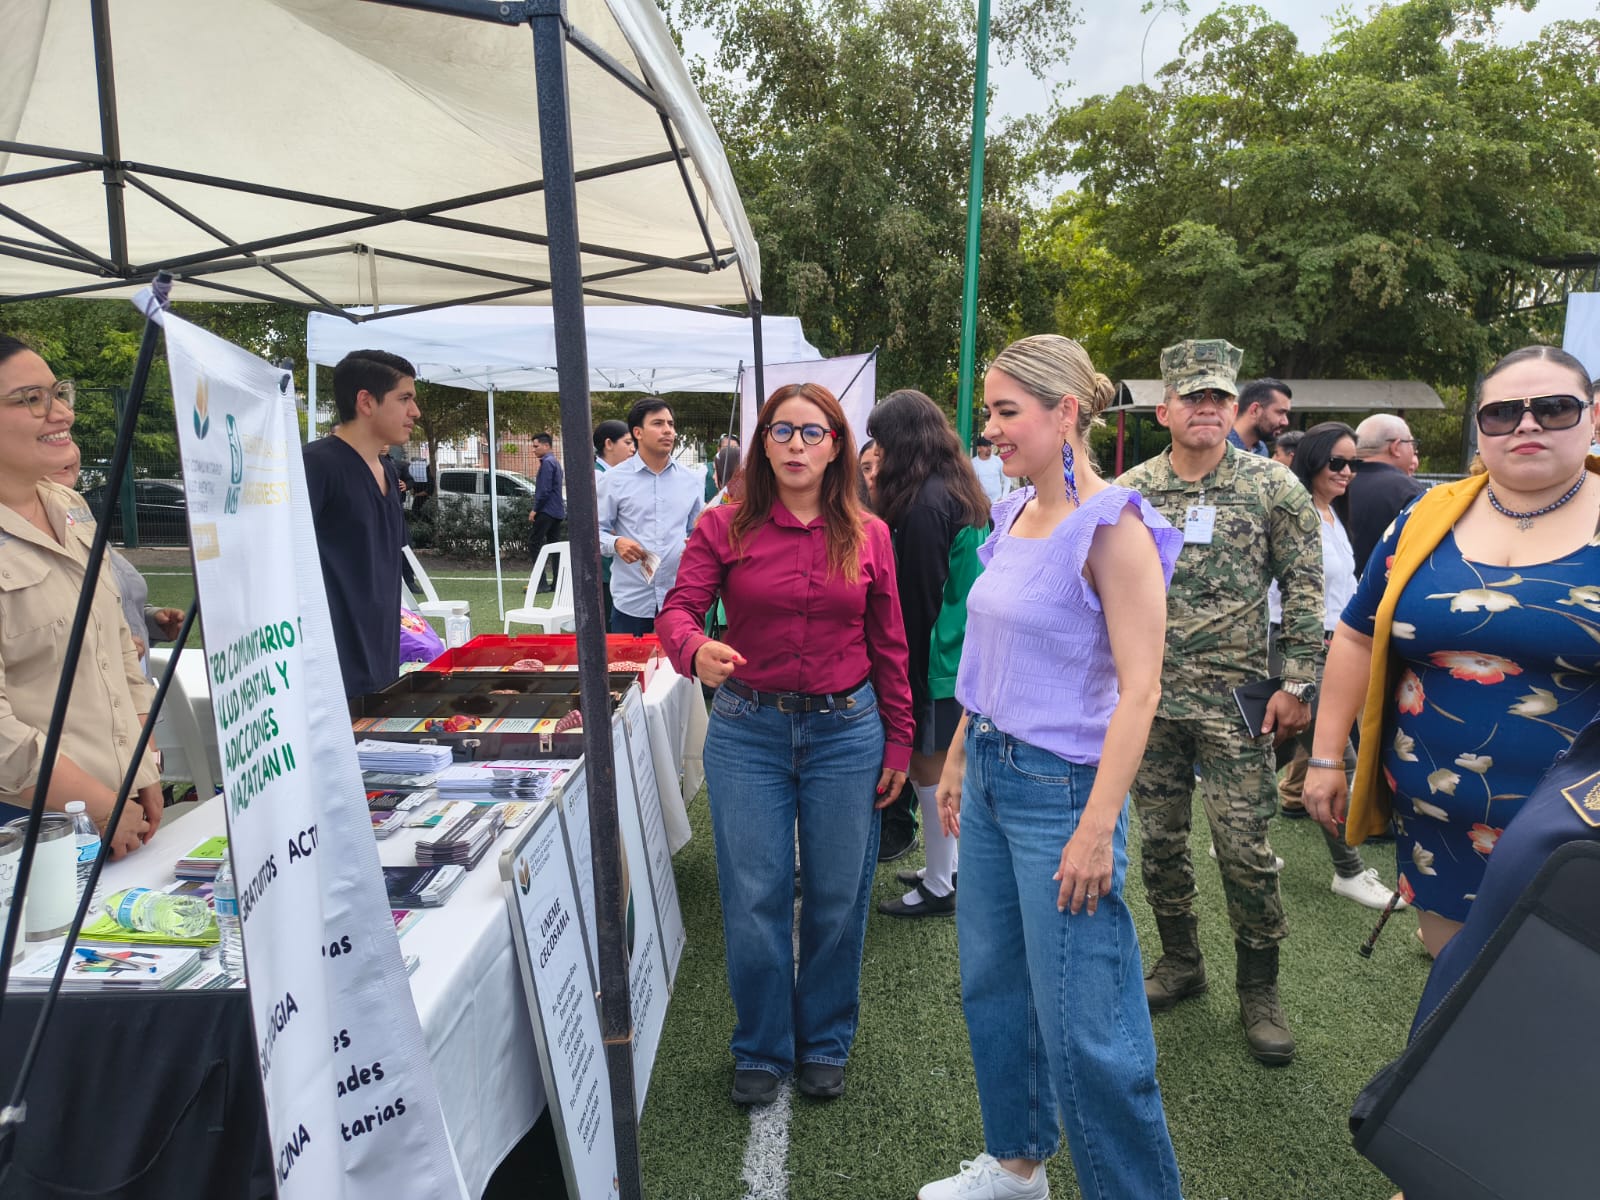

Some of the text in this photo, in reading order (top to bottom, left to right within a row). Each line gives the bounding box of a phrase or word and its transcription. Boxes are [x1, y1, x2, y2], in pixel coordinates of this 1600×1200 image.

[228, 620, 295, 681] COMUNITARIO
[239, 665, 276, 717] MENTAL
[275, 660, 290, 690] Y
[225, 707, 279, 777] ADICCIONES
[230, 747, 282, 824] MAZATLAN
[539, 910, 570, 969] CECOSAMA
[540, 897, 562, 938] UNEME
